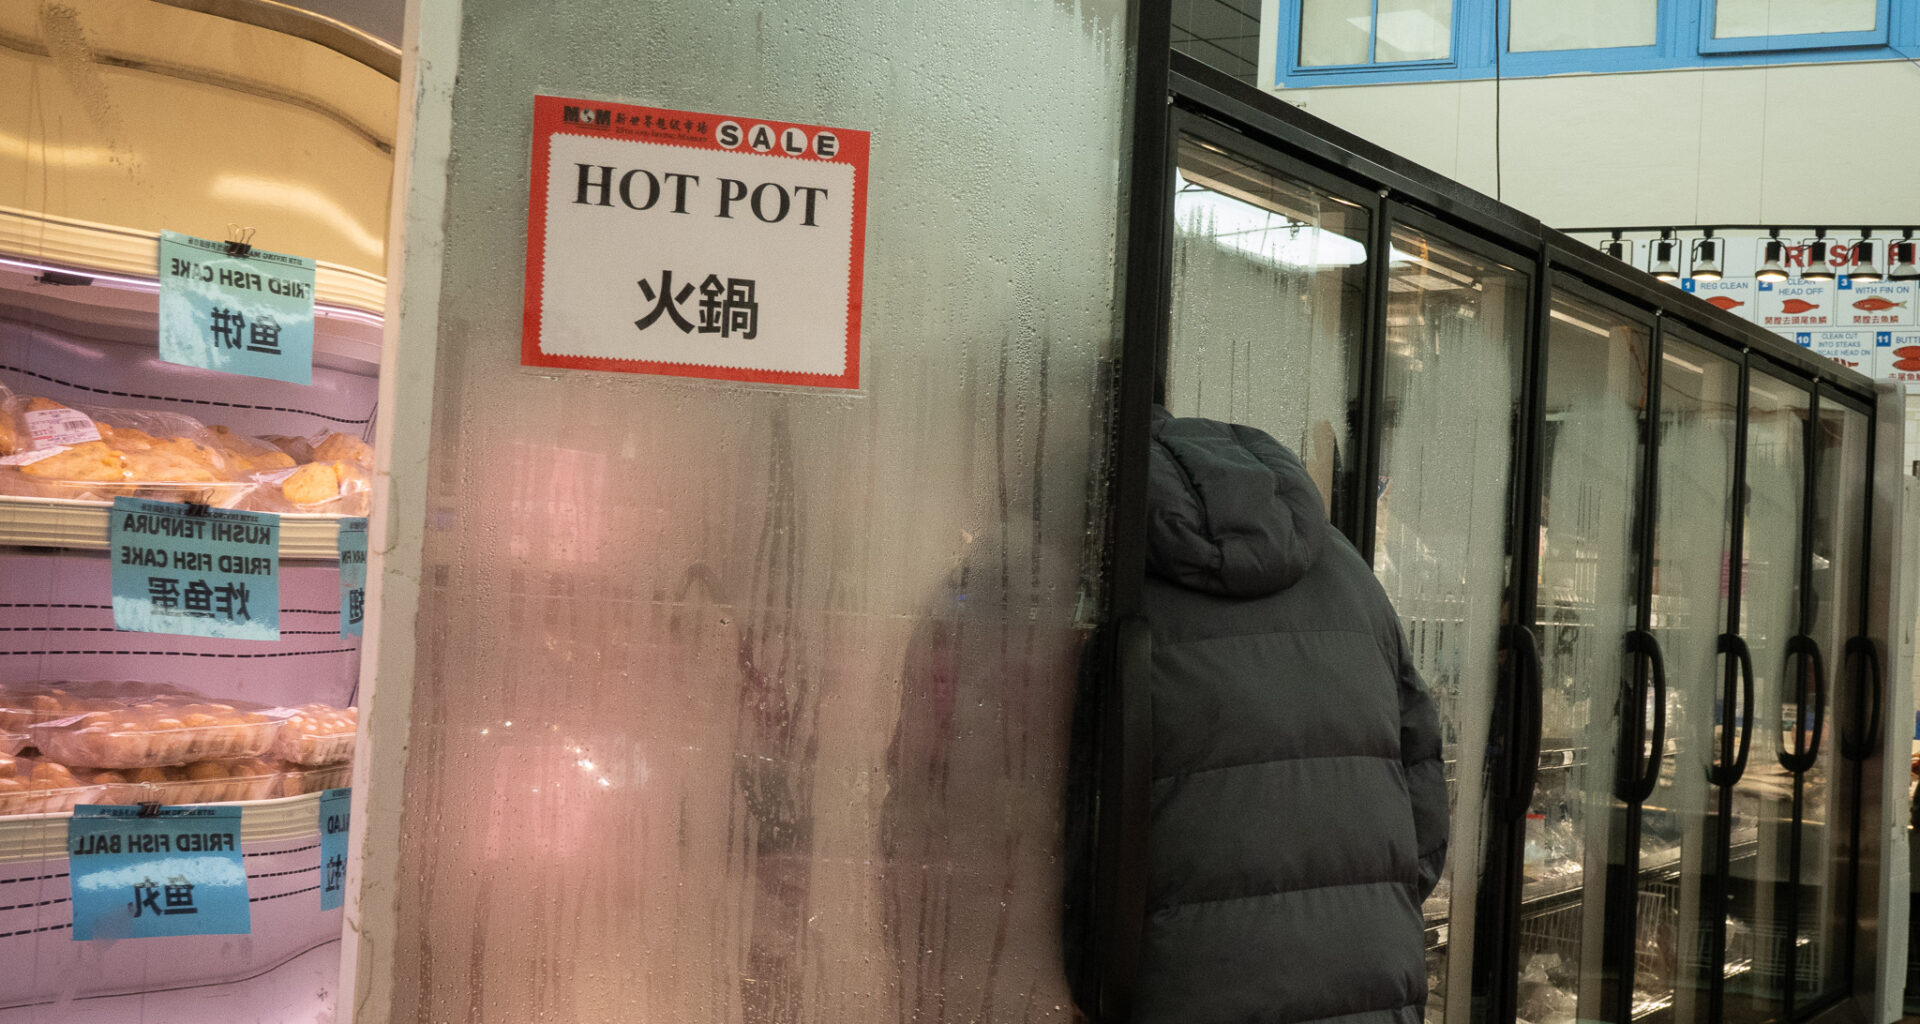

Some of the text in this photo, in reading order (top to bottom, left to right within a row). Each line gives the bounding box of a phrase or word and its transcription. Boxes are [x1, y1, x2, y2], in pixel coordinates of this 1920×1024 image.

[720, 124, 835, 157] SALE
[572, 163, 828, 227] HOT POT
[1701, 282, 1718, 290] REG
[1879, 286, 1894, 294] FIN
[1896, 286, 1910, 294] ON
[1779, 287, 1824, 296] HEAD OFF
[634, 269, 758, 340] 火鍋
[1798, 336, 1809, 344] 10
[1878, 335, 1890, 344] 11
